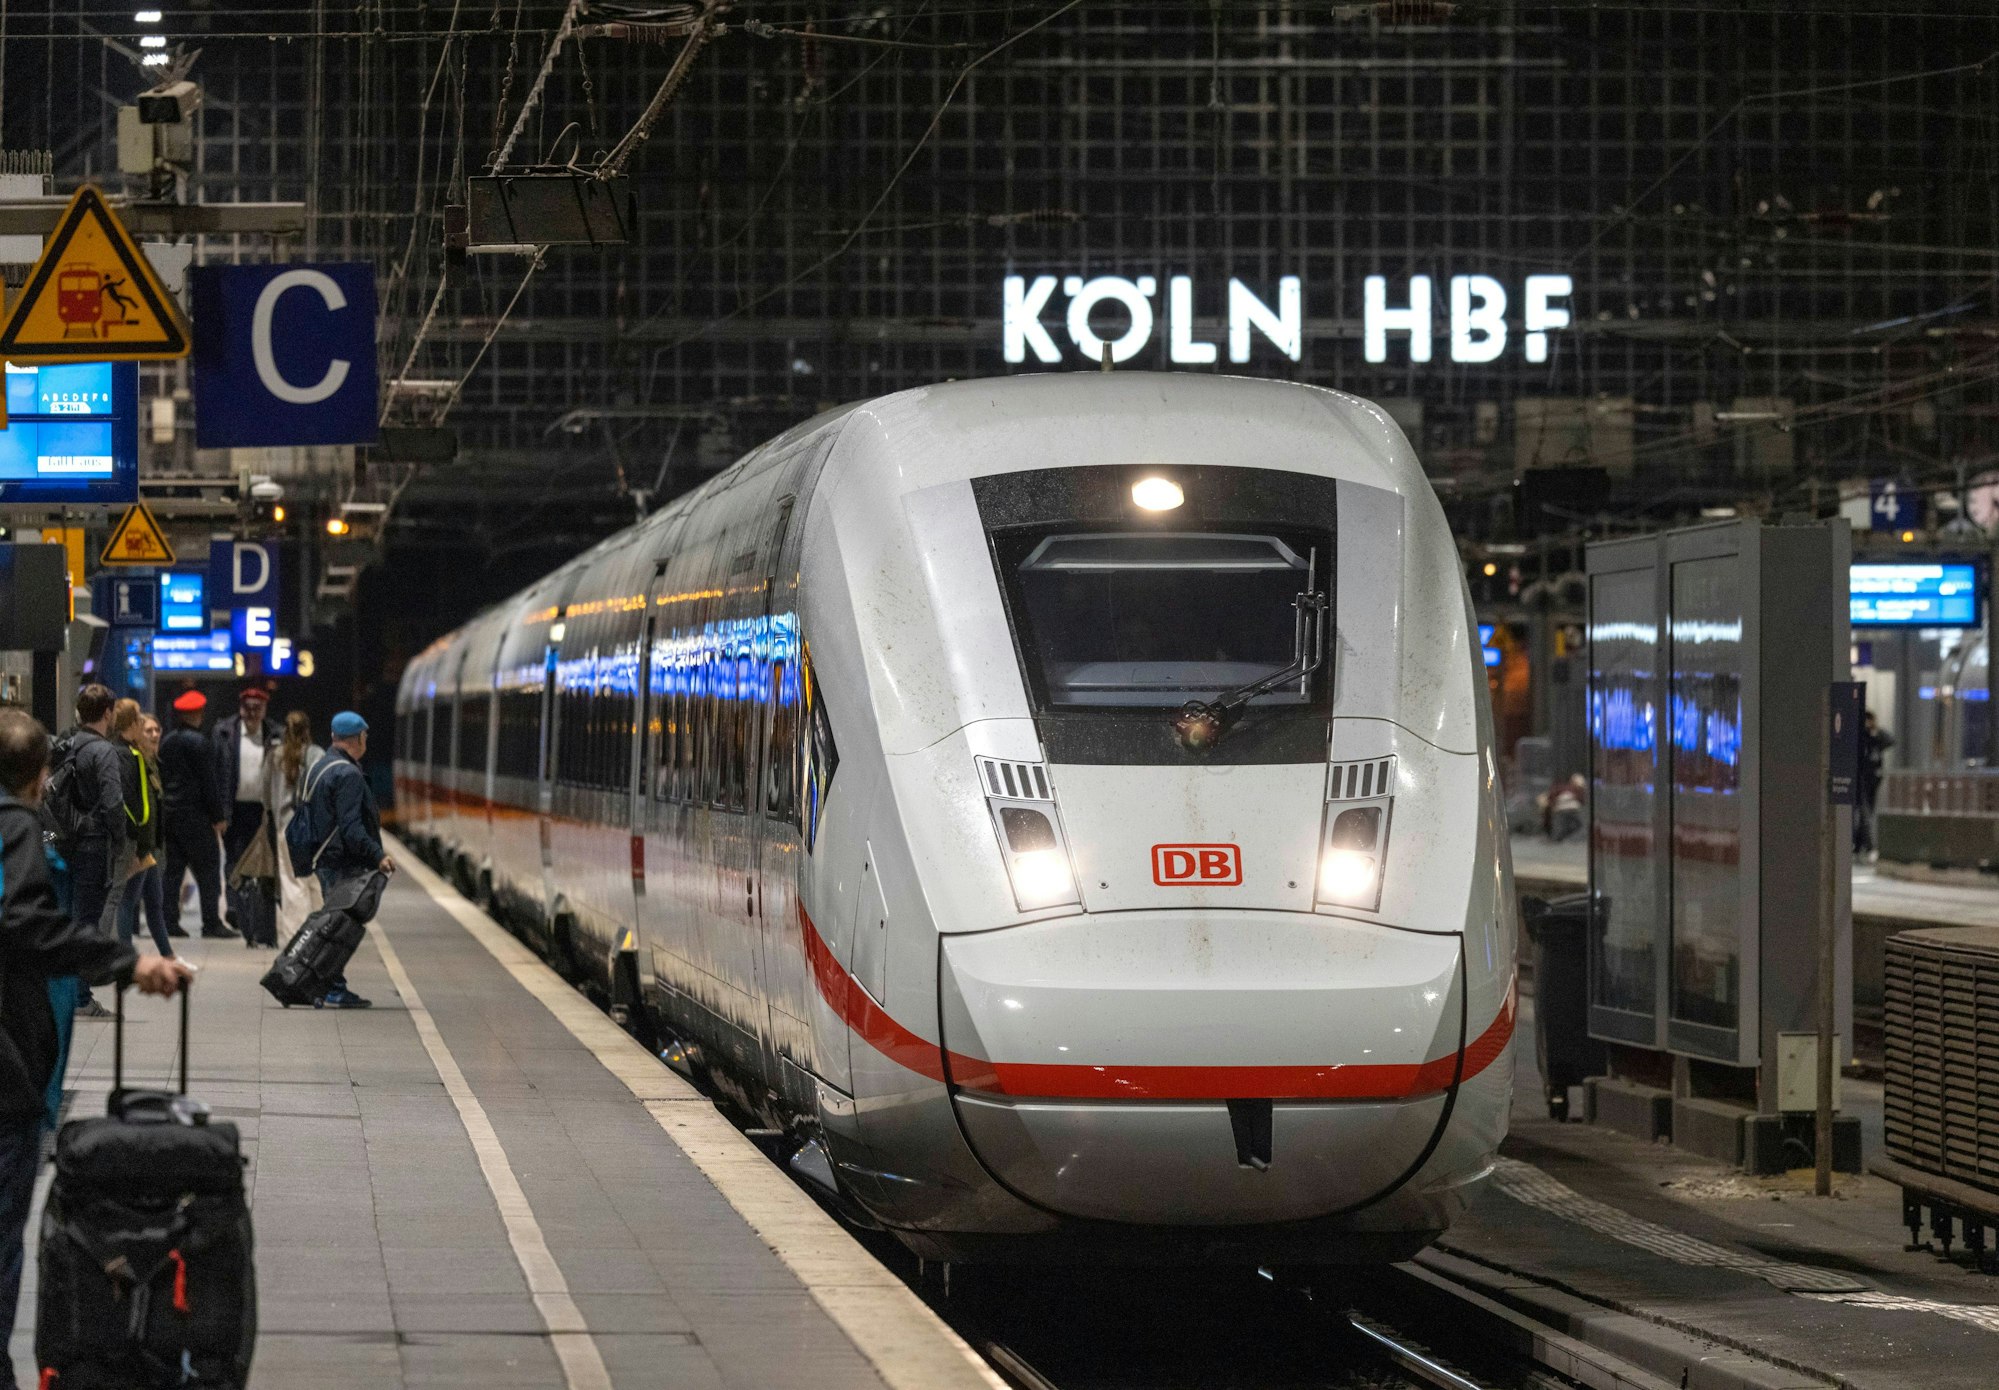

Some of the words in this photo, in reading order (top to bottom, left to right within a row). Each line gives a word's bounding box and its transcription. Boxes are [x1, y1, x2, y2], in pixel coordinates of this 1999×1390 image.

[252, 268, 351, 405] C
[1003, 275, 1302, 363] KÖLN
[1364, 275, 1574, 363] HBF
[1874, 481, 1900, 522] 4
[232, 541, 271, 595] D
[245, 606, 272, 647] E
[271, 637, 292, 670] F
[1163, 850, 1232, 879] DB
